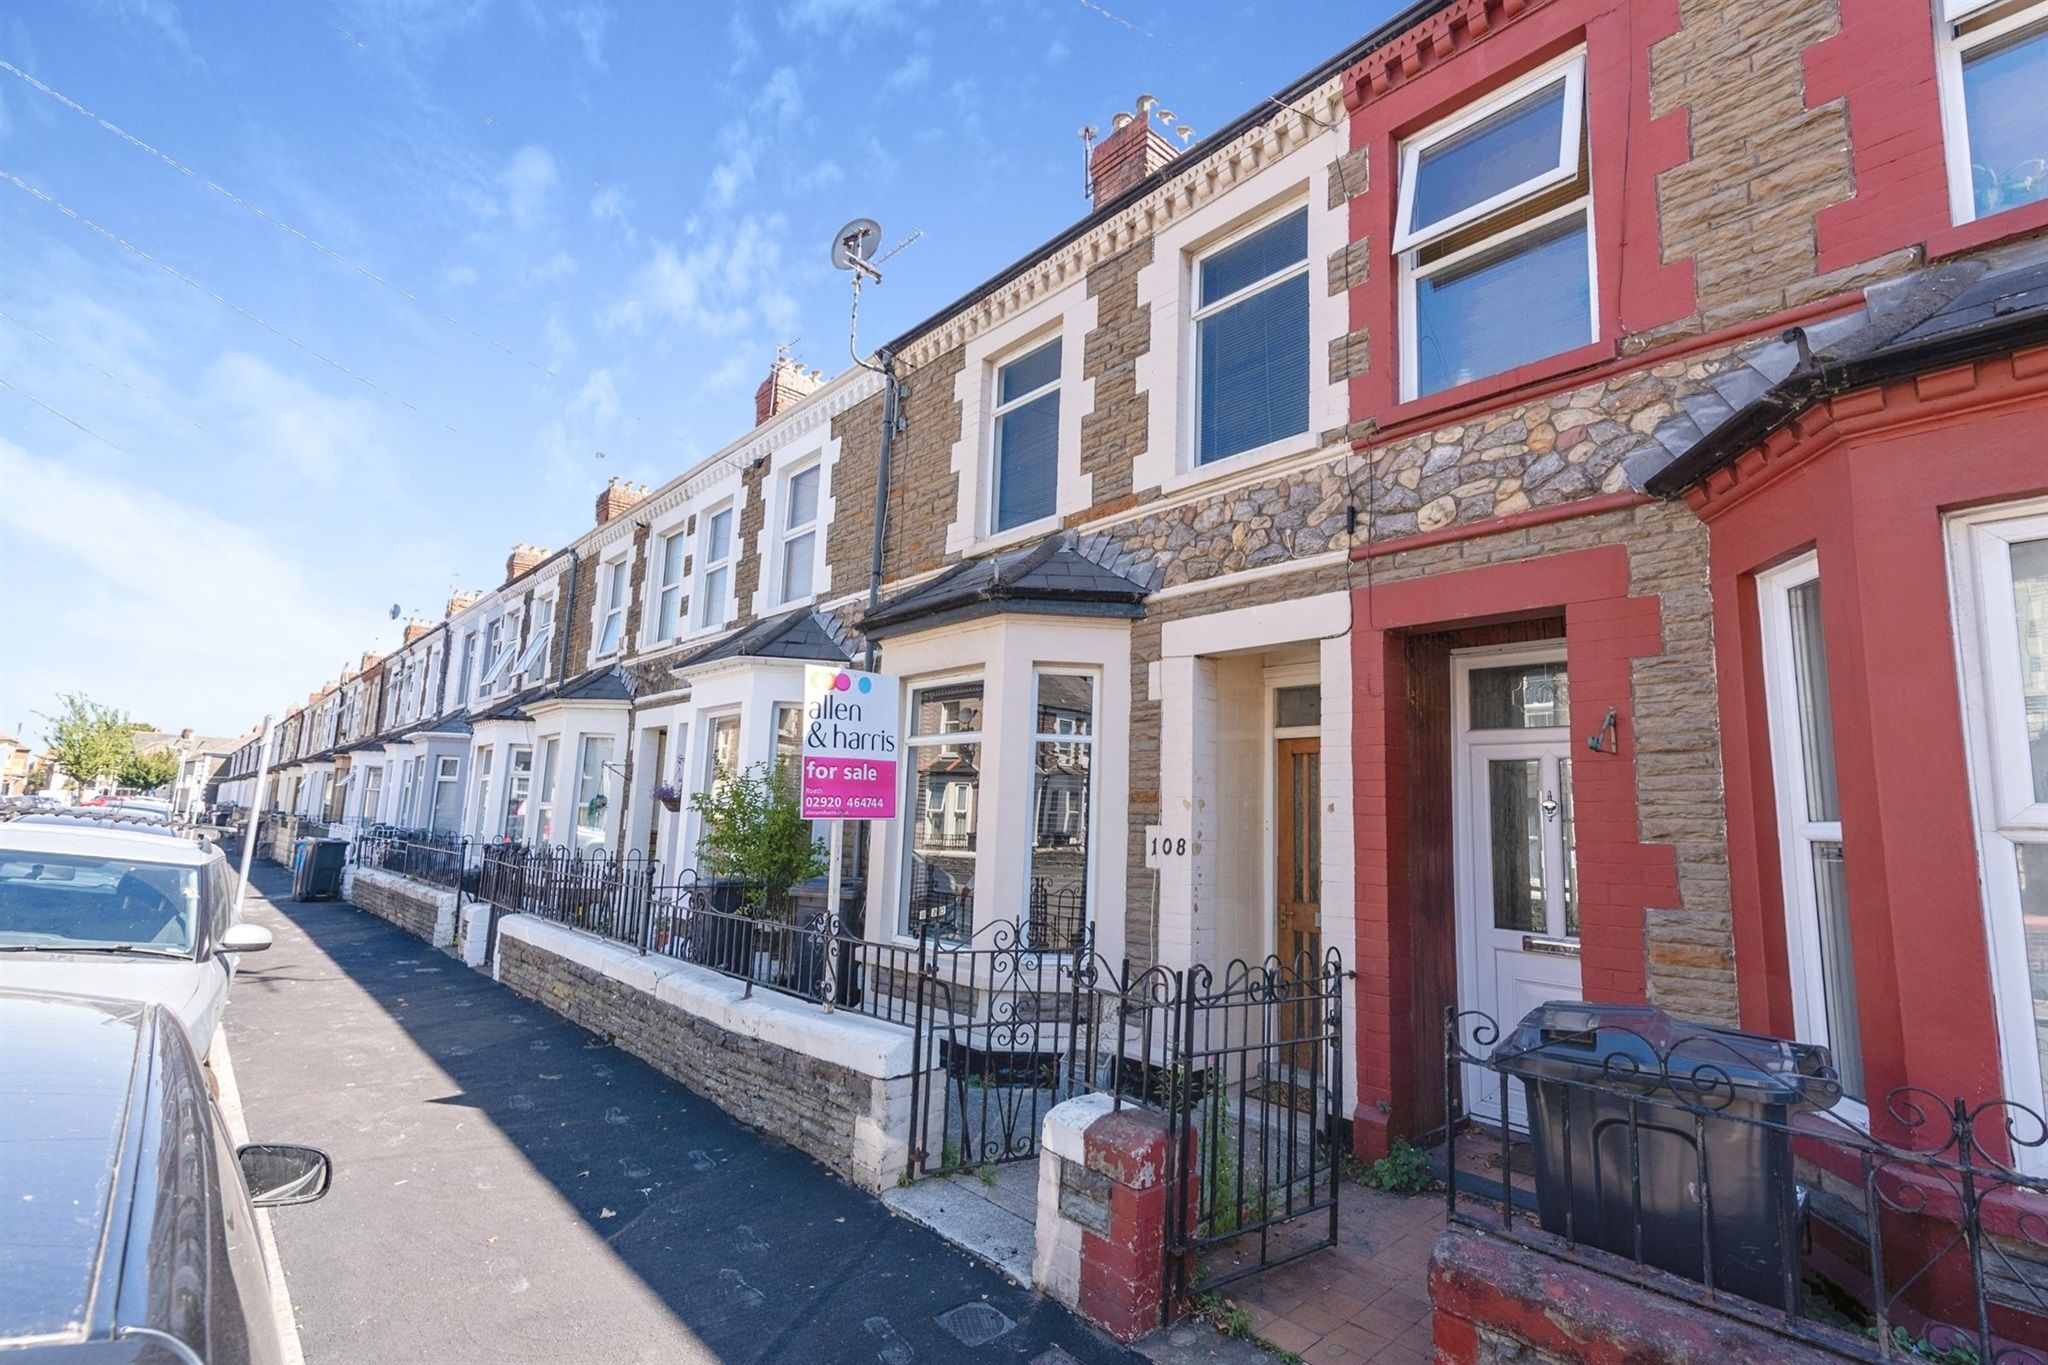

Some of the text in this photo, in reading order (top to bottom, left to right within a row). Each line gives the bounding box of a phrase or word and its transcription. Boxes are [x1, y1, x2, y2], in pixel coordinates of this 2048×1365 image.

[808, 694, 862, 722] allen
[807, 721, 895, 753] & harris
[806, 761, 877, 782] for sale
[805, 796, 884, 809] 02920 464744
[1151, 837, 1186, 856] 108
